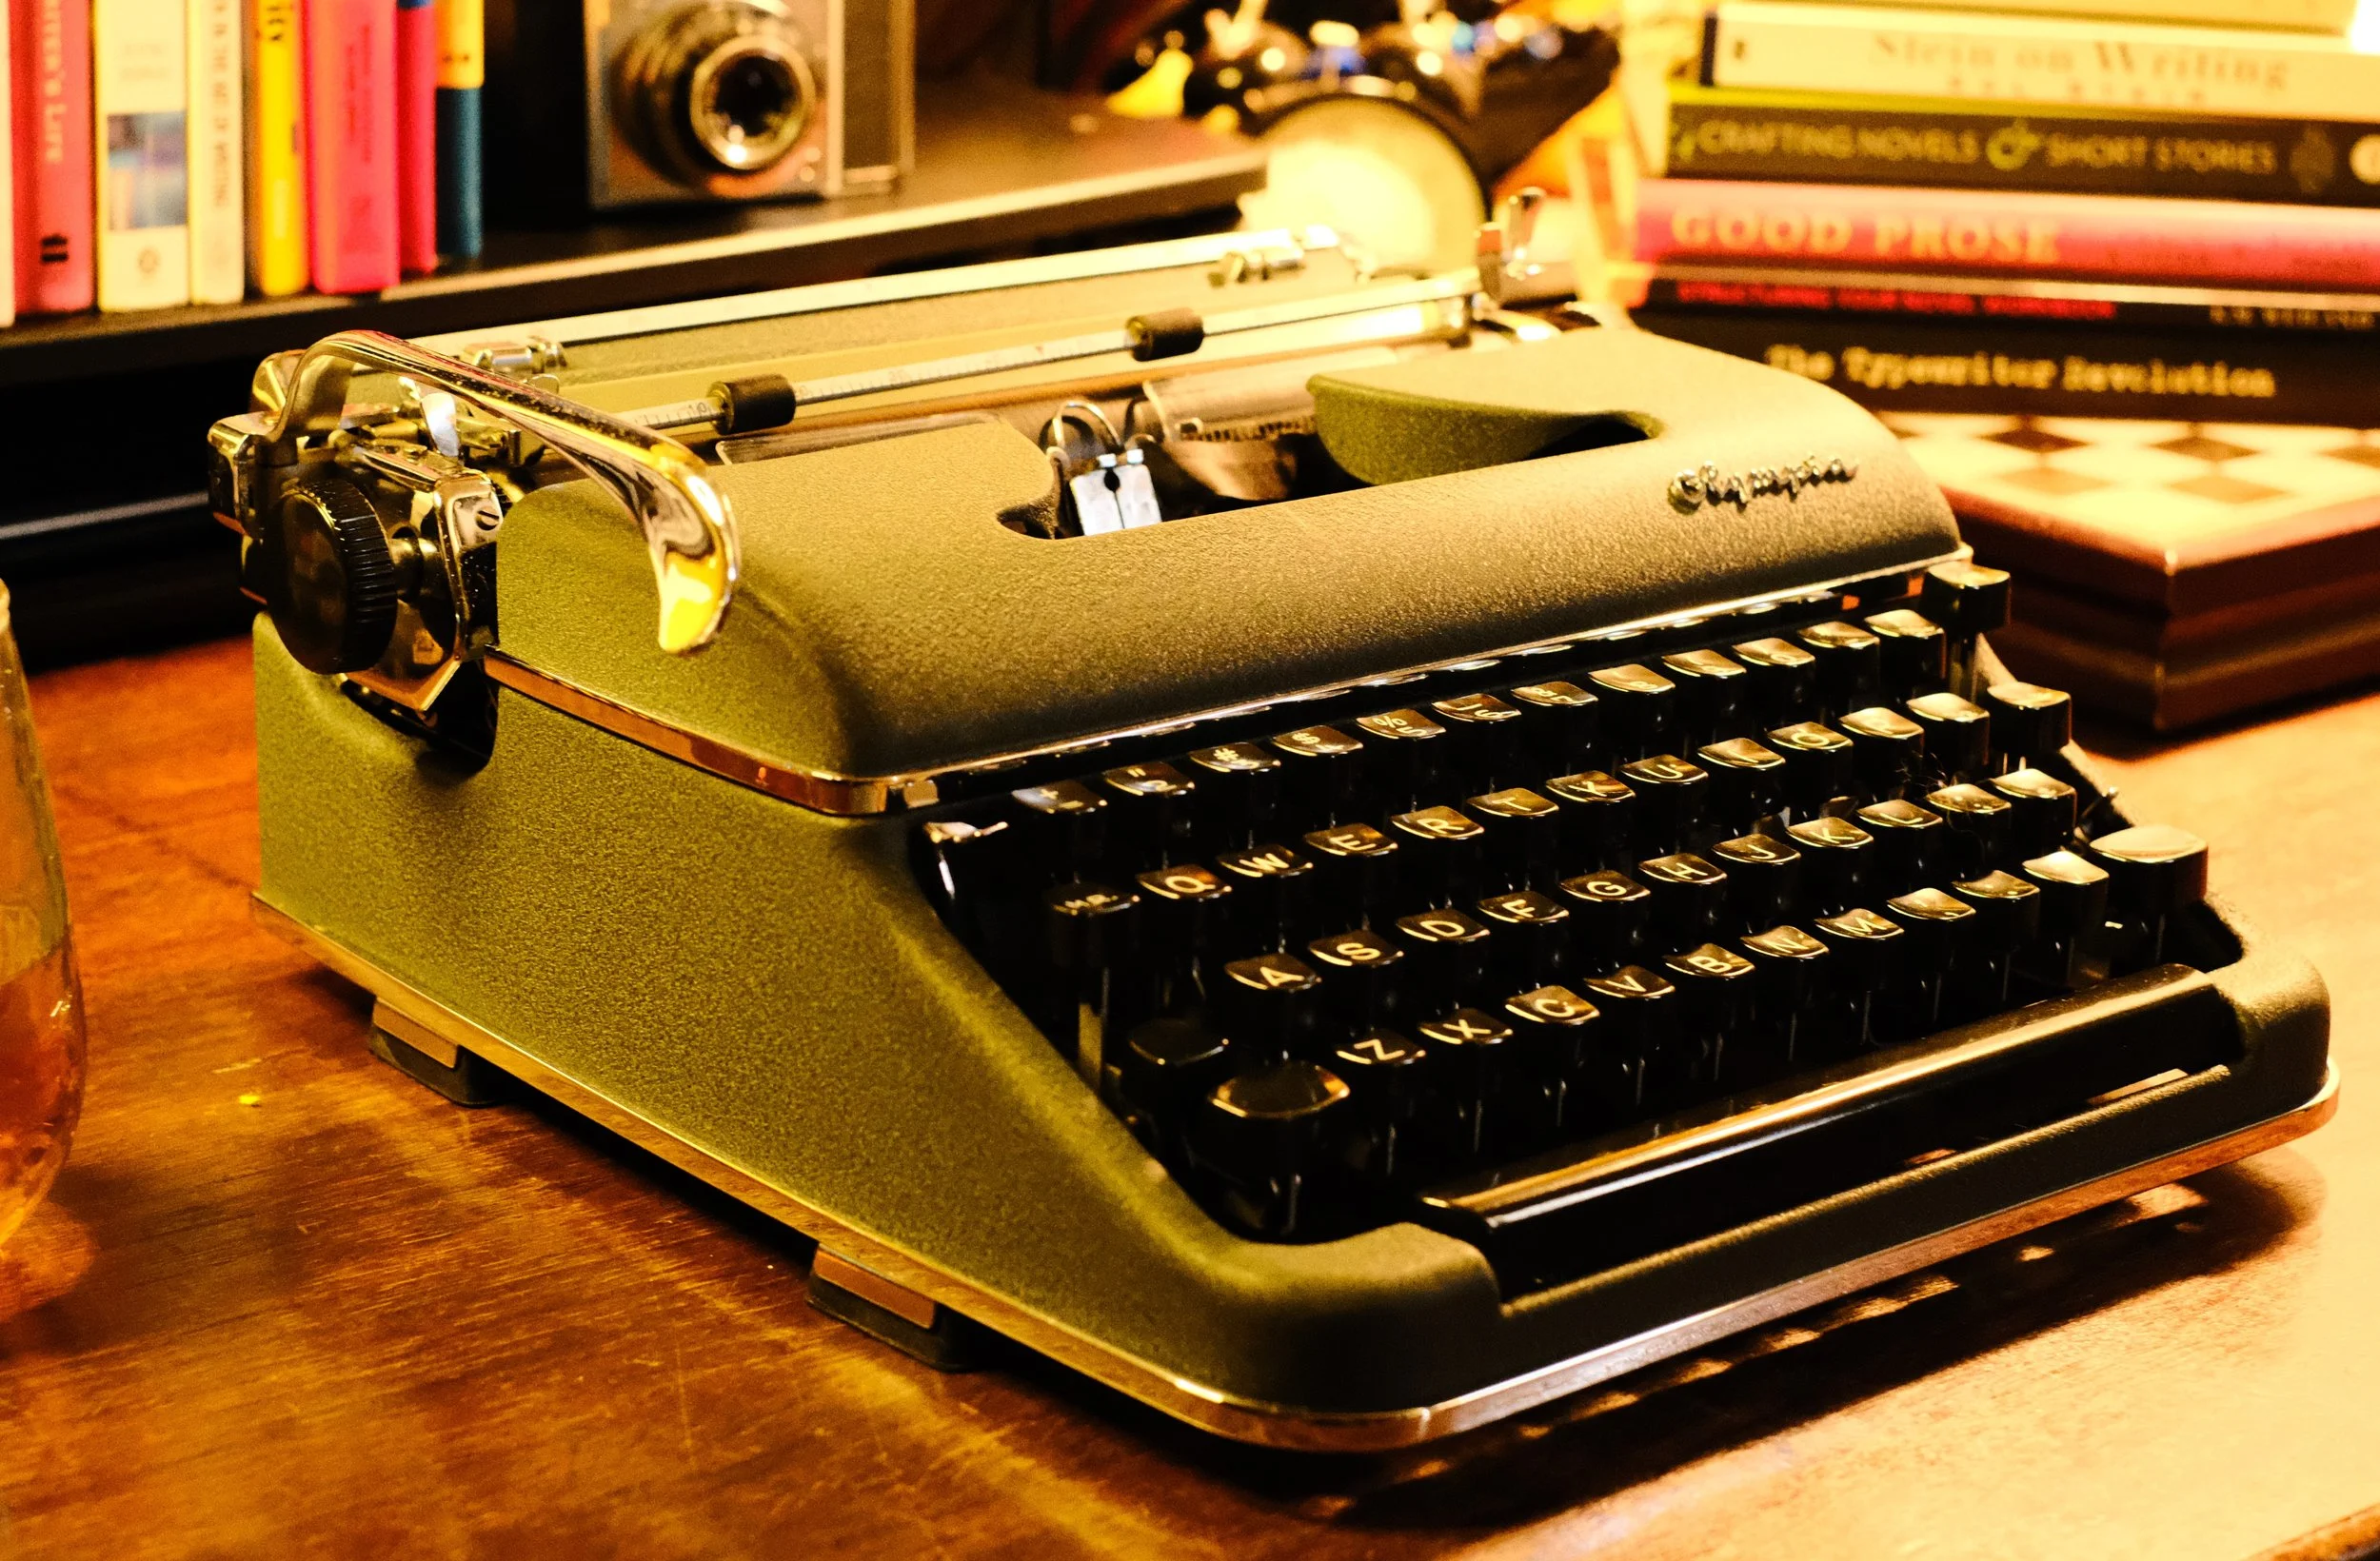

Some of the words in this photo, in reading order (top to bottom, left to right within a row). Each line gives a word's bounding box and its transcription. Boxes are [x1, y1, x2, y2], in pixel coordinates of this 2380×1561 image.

[1671, 205, 1854, 253] GOOD
[1874, 215, 2060, 264] PROSE
[1764, 343, 1835, 382] The
[1841, 345, 2058, 390] Typewriter
[2061, 354, 2277, 399] Revolution
[1667, 454, 1858, 514] Olympia
[1791, 731, 1831, 747] O
[1641, 763, 1684, 780] U
[1492, 797, 1532, 812] T
[1416, 817, 1465, 835] R
[1809, 826, 1855, 844] K
[1328, 834, 1378, 852] E
[1750, 843, 1777, 860] J
[1238, 852, 1290, 874] W
[1660, 861, 1709, 880] H
[1163, 875, 1217, 894] Q
[1586, 880, 1628, 897] G
[1501, 898, 1536, 919] F
[1419, 919, 1466, 938] D
[1835, 917, 1887, 936] M
[1336, 941, 1381, 961] S
[1762, 937, 1810, 954] N
[1686, 955, 1734, 974] B
[1259, 965, 1305, 987] A
[1604, 975, 1647, 993] V
[1535, 998, 1577, 1018] C
[1441, 1018, 1492, 1039] X
[1353, 1038, 1406, 1060] Z
